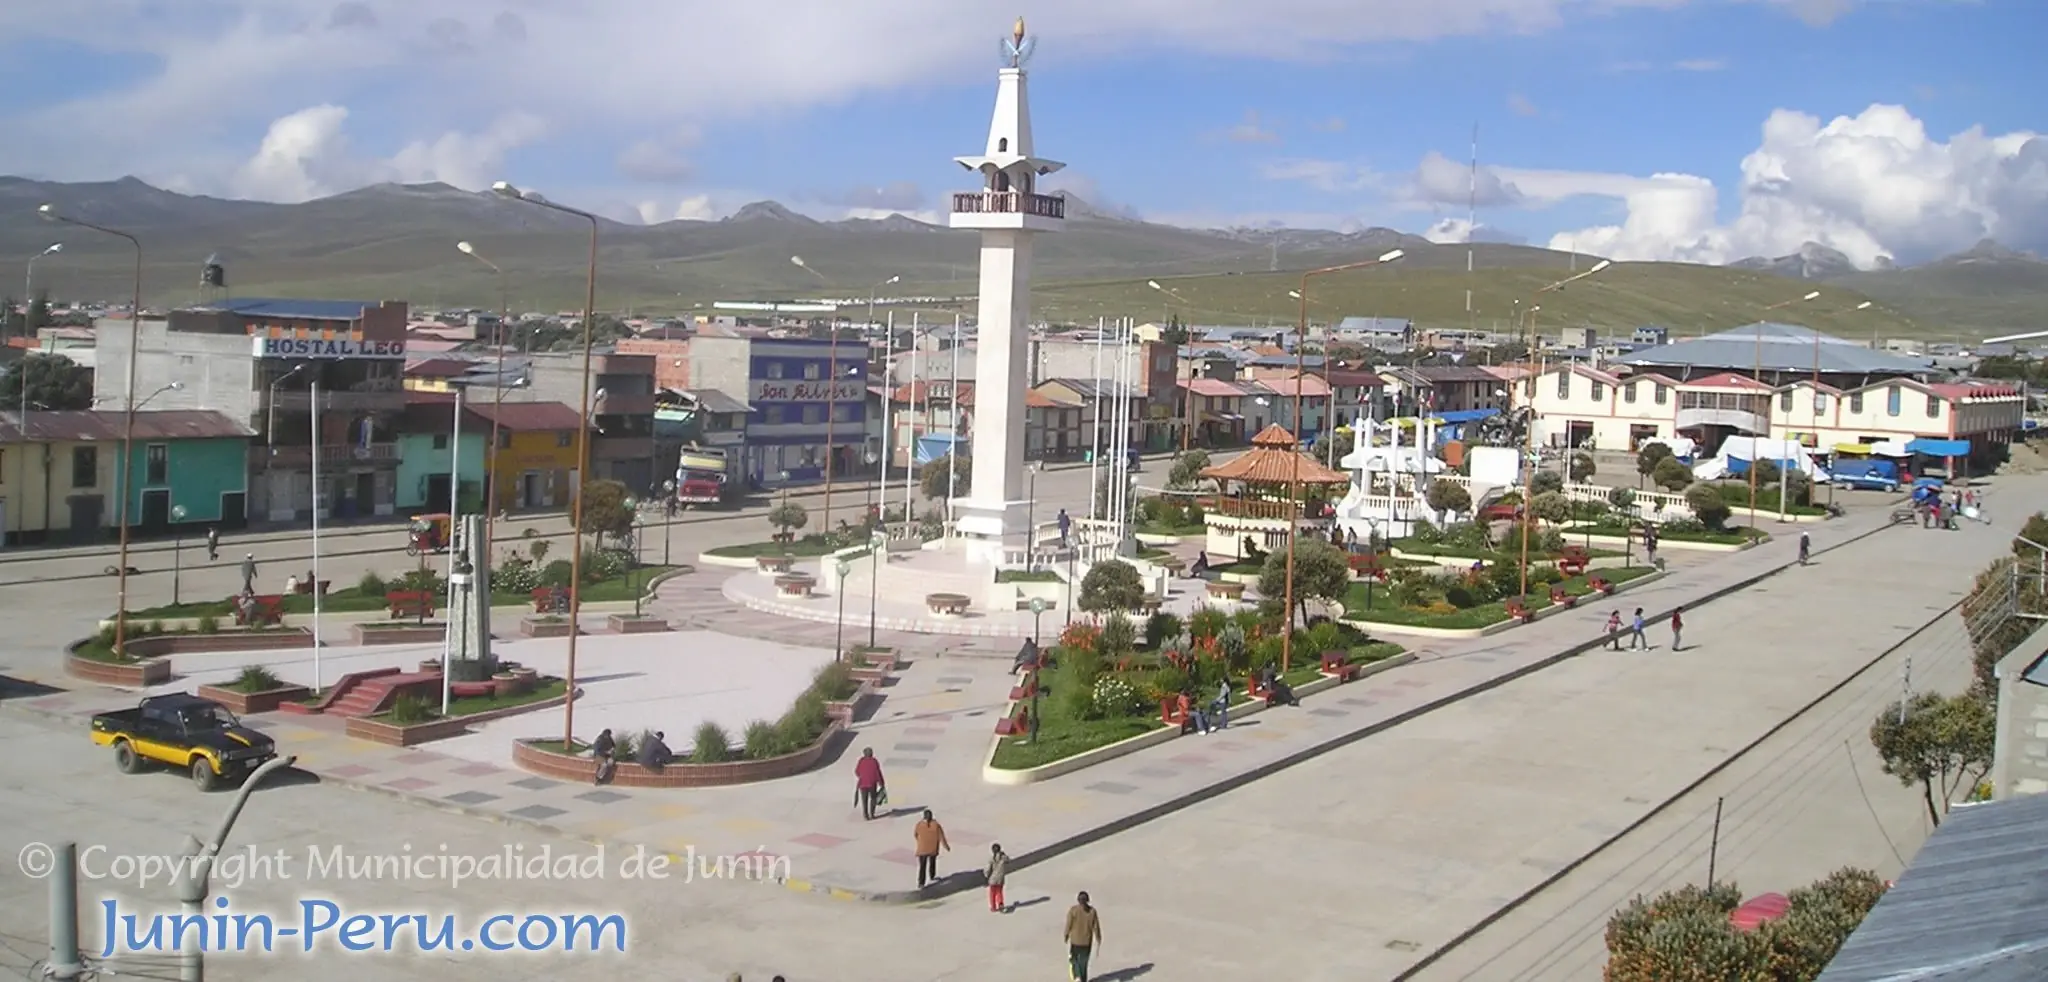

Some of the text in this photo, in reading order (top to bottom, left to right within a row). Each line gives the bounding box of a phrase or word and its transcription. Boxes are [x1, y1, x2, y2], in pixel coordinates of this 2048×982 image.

[264, 339, 404, 356] HOSTAL LEO
[758, 382, 788, 400] San
